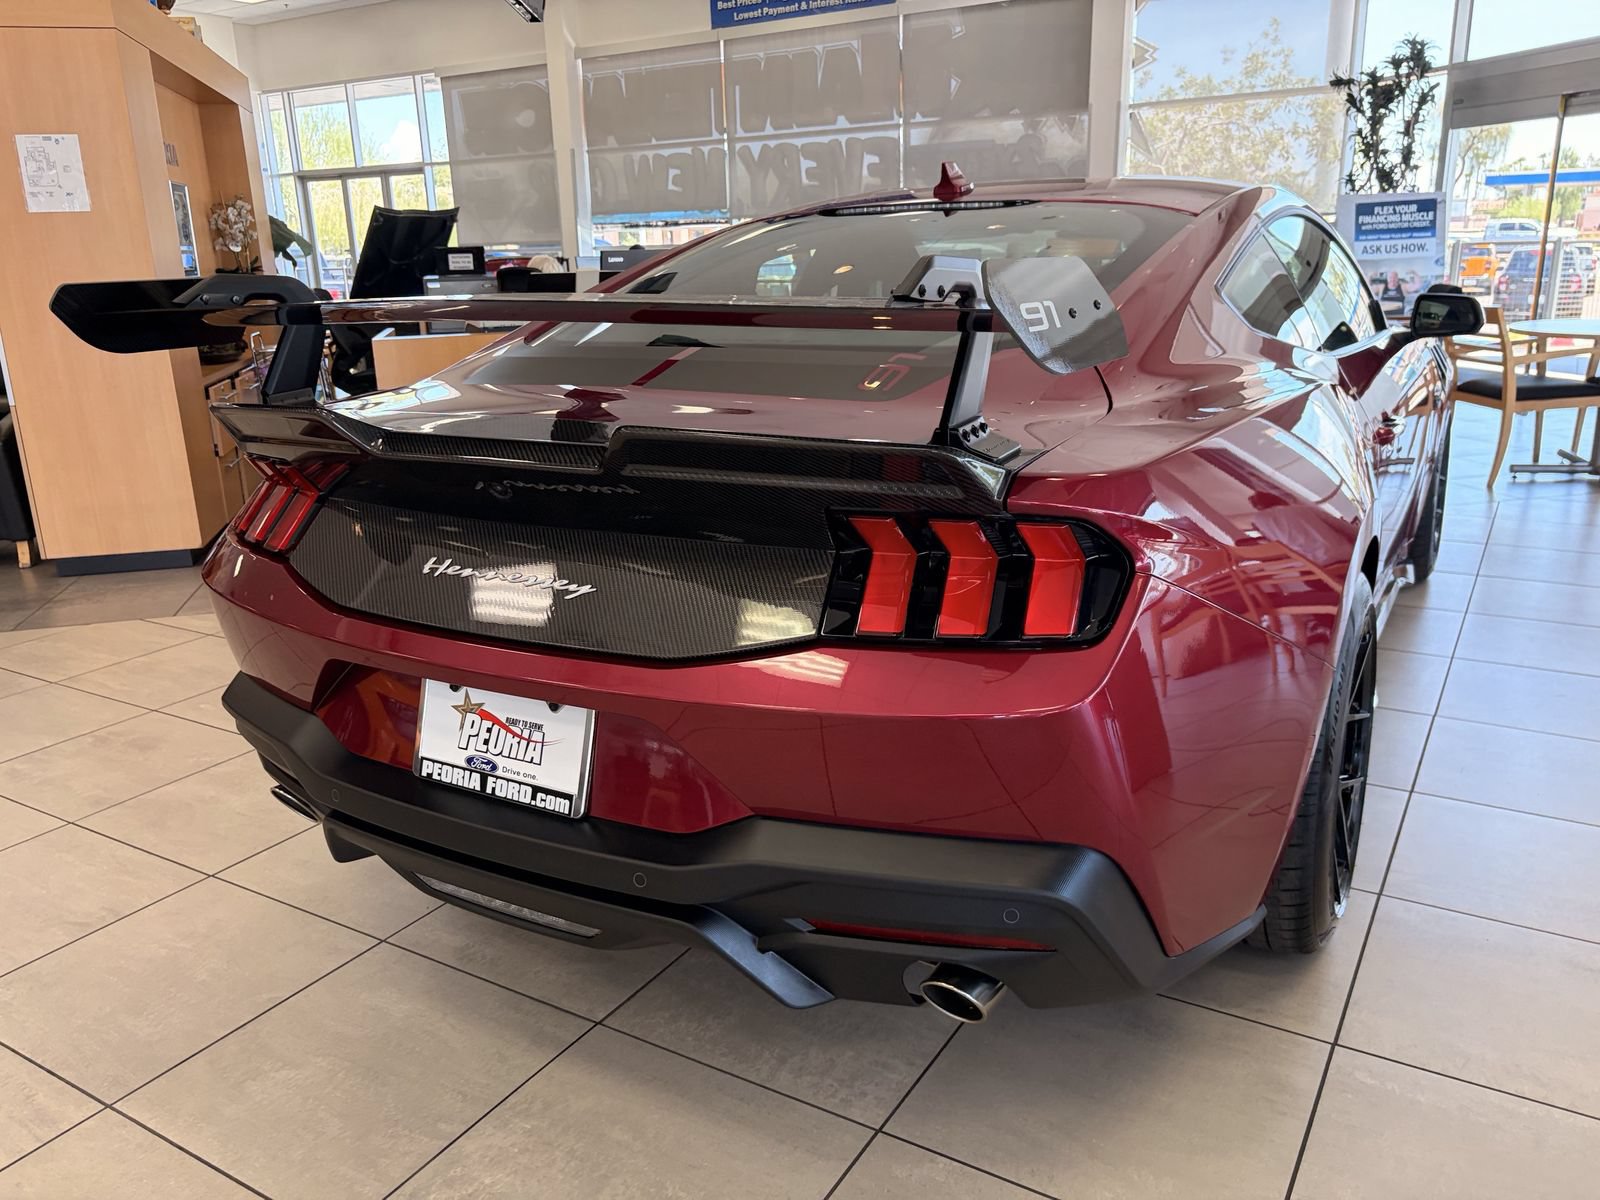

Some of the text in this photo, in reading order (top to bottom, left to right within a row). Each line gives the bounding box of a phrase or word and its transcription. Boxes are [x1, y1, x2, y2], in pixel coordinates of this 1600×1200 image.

[717, 0, 736, 10] Best
[733, 0, 843, 21] Lowest Payment & Interest
[1374, 204, 1418, 215] FLEX YOUR
[1359, 211, 1434, 224] FINANCING MUSCLE
[1388, 221, 1409, 229] MOTOR
[1361, 242, 1429, 255] ASK US HOW.
[1020, 300, 1062, 333] 91
[422, 556, 597, 600] Hennessey
[505, 716, 544, 731] READY TO SERVE
[458, 711, 545, 766] PEORIA
[470, 756, 493, 772] Ford
[502, 766, 539, 781] Drive one.
[421, 760, 570, 815] PEORIA FORD.com
